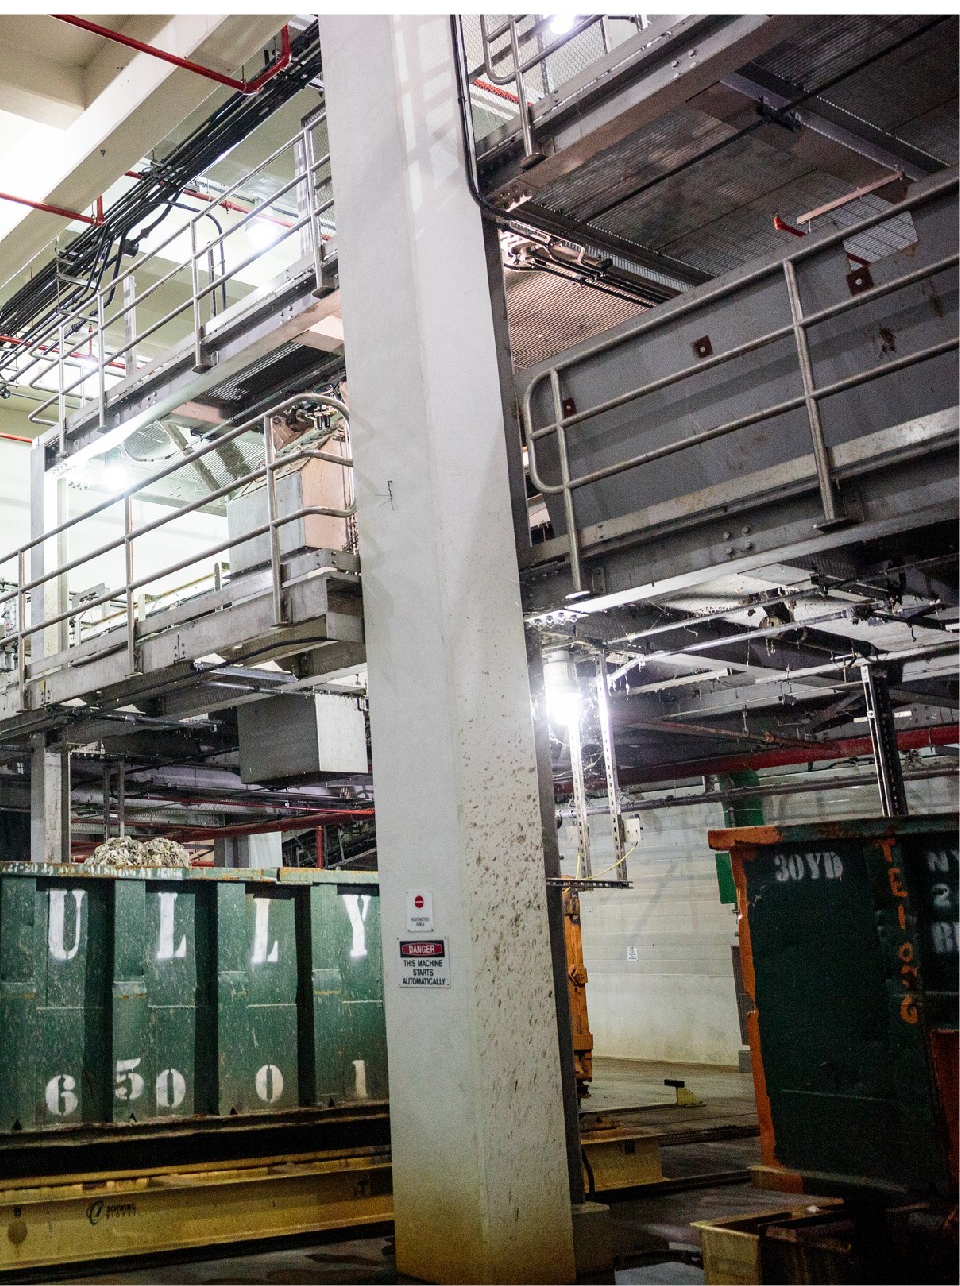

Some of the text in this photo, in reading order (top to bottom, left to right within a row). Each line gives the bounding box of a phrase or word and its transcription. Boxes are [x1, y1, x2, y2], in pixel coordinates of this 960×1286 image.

[408, 945, 435, 954] DANGER
[413, 968, 434, 977] STARTS
[402, 977, 446, 986] AUTOMATICALLY
